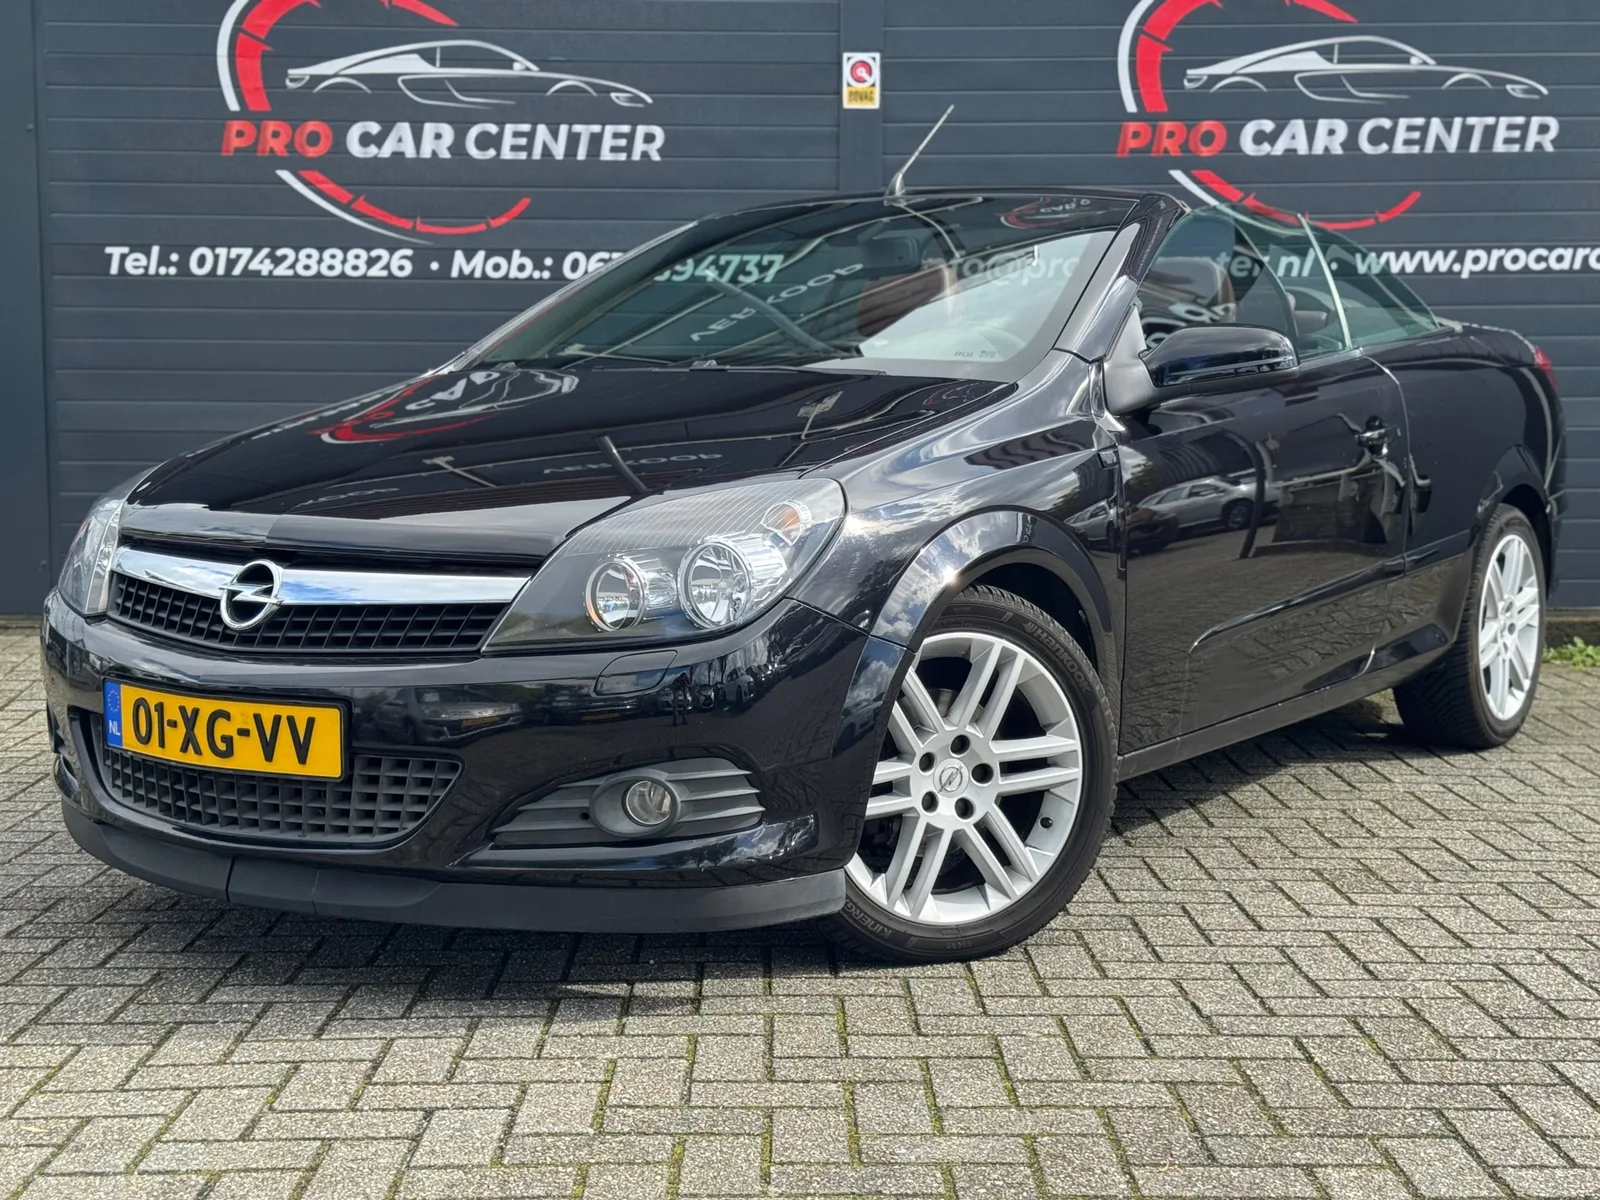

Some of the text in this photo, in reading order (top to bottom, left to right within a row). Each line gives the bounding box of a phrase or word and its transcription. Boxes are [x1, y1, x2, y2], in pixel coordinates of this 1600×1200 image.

[221, 120, 665, 161] PRO CAR CENTER
[1117, 116, 1560, 157] PRO CAR CENTER
[105, 245, 180, 276] Tel.:
[189, 247, 414, 277] 0174288826
[451, 249, 554, 280] Mob.:
[108, 719, 121, 737] NL
[132, 696, 316, 765] 01-XG-VV
